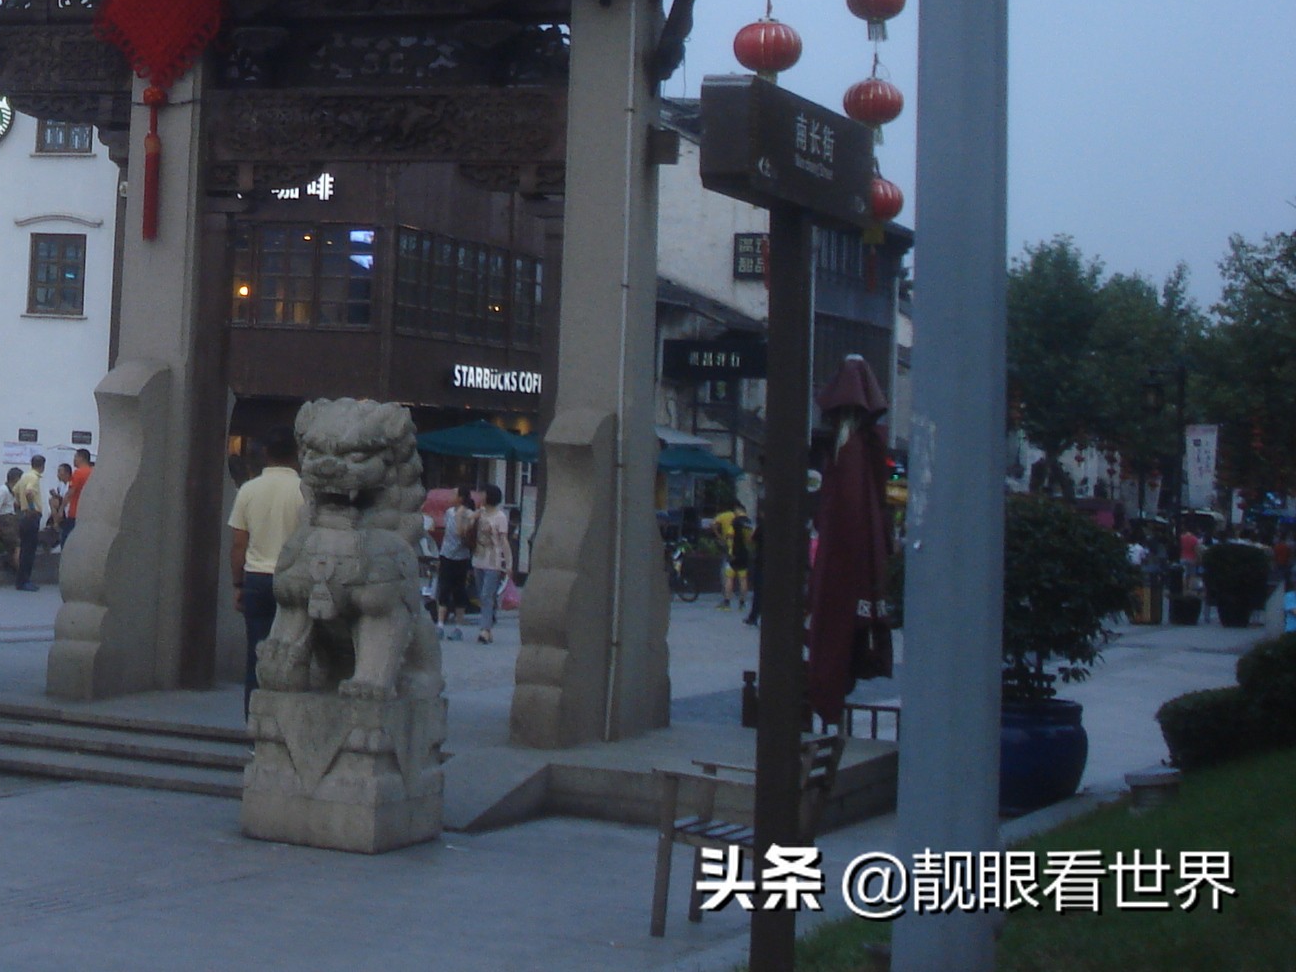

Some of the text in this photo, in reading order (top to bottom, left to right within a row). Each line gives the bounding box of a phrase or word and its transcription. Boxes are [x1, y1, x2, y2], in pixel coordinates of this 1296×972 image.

[795, 113, 834, 163] 南长街
[453, 364, 518, 392] STARBUCKS
